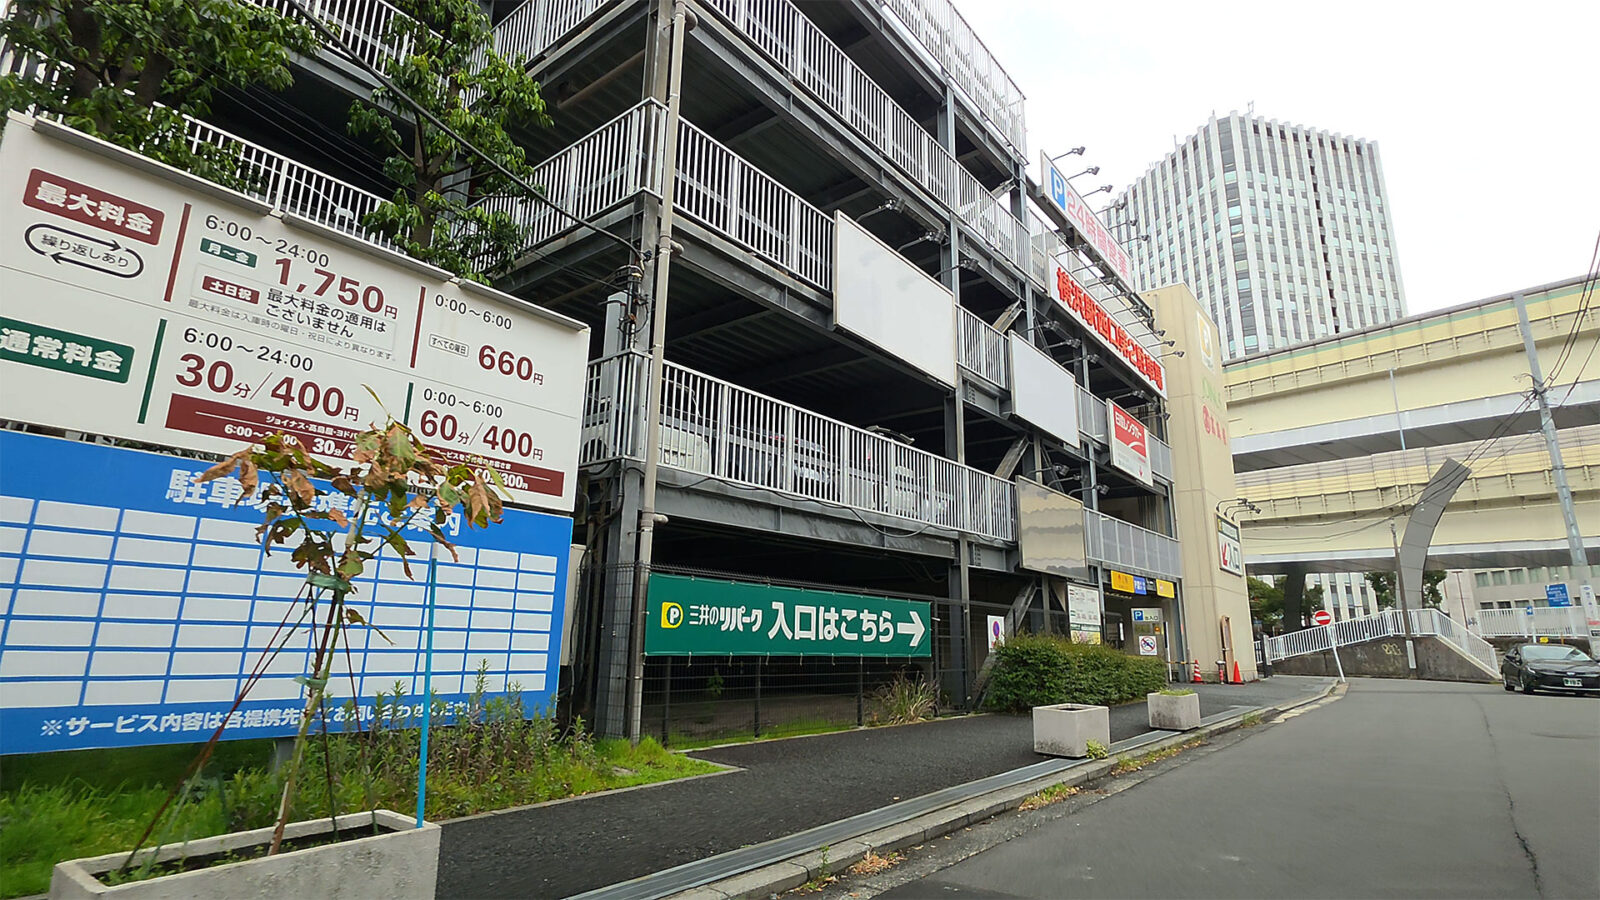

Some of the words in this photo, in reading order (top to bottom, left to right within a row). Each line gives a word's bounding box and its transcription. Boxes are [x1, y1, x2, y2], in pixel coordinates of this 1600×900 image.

[35, 181, 153, 235] 最大料金
[41, 234, 129, 267] 繰り返しあり
[205, 214, 329, 268] 6:00～24:00
[207, 242, 250, 264] 月～金
[209, 281, 252, 300] 土日祝
[275, 257, 398, 320] 1,750円
[266, 304, 354, 338] ございません
[267, 288, 387, 333] 最大料金の適用は
[435, 294, 512, 330] 0:00～6:00
[0, 328, 123, 373] 通常料金
[184, 328, 313, 371] 6:00～24:00
[431, 337, 467, 355] すべての曜日
[478, 345, 544, 385] 660円
[176, 353, 359, 422] 30分/400円
[423, 388, 503, 418] 0:00～6:00
[420, 409, 543, 461] 60分/400円
[689, 604, 763, 632] 三井のリパーク
[768, 601, 894, 643] 入口はこちら
